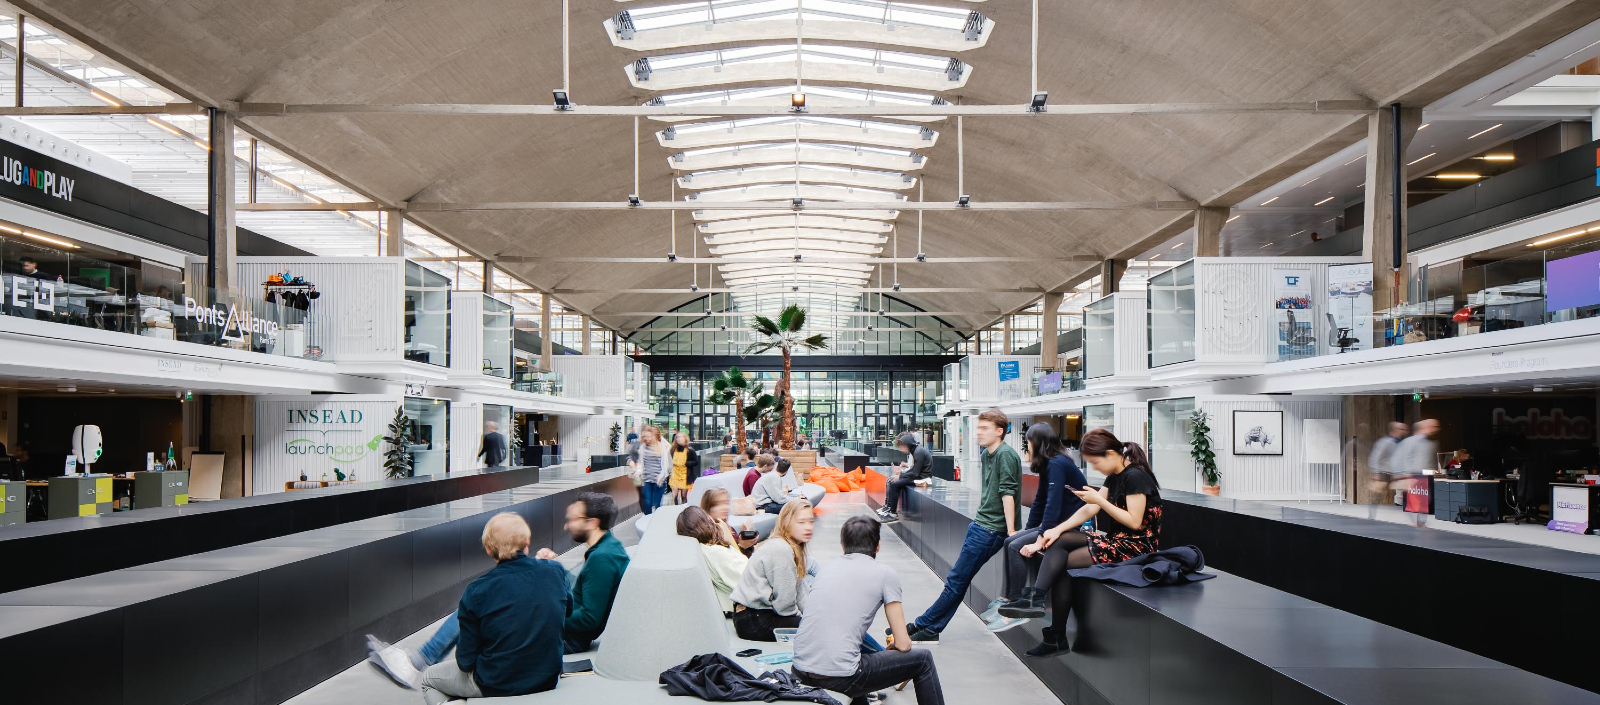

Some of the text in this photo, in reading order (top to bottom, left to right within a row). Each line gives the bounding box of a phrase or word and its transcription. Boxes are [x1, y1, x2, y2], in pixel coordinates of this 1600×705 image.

[1491, 357, 1547, 370] Founders Program
[287, 409, 363, 424] INSEAD
[285, 442, 364, 457] launchpad
